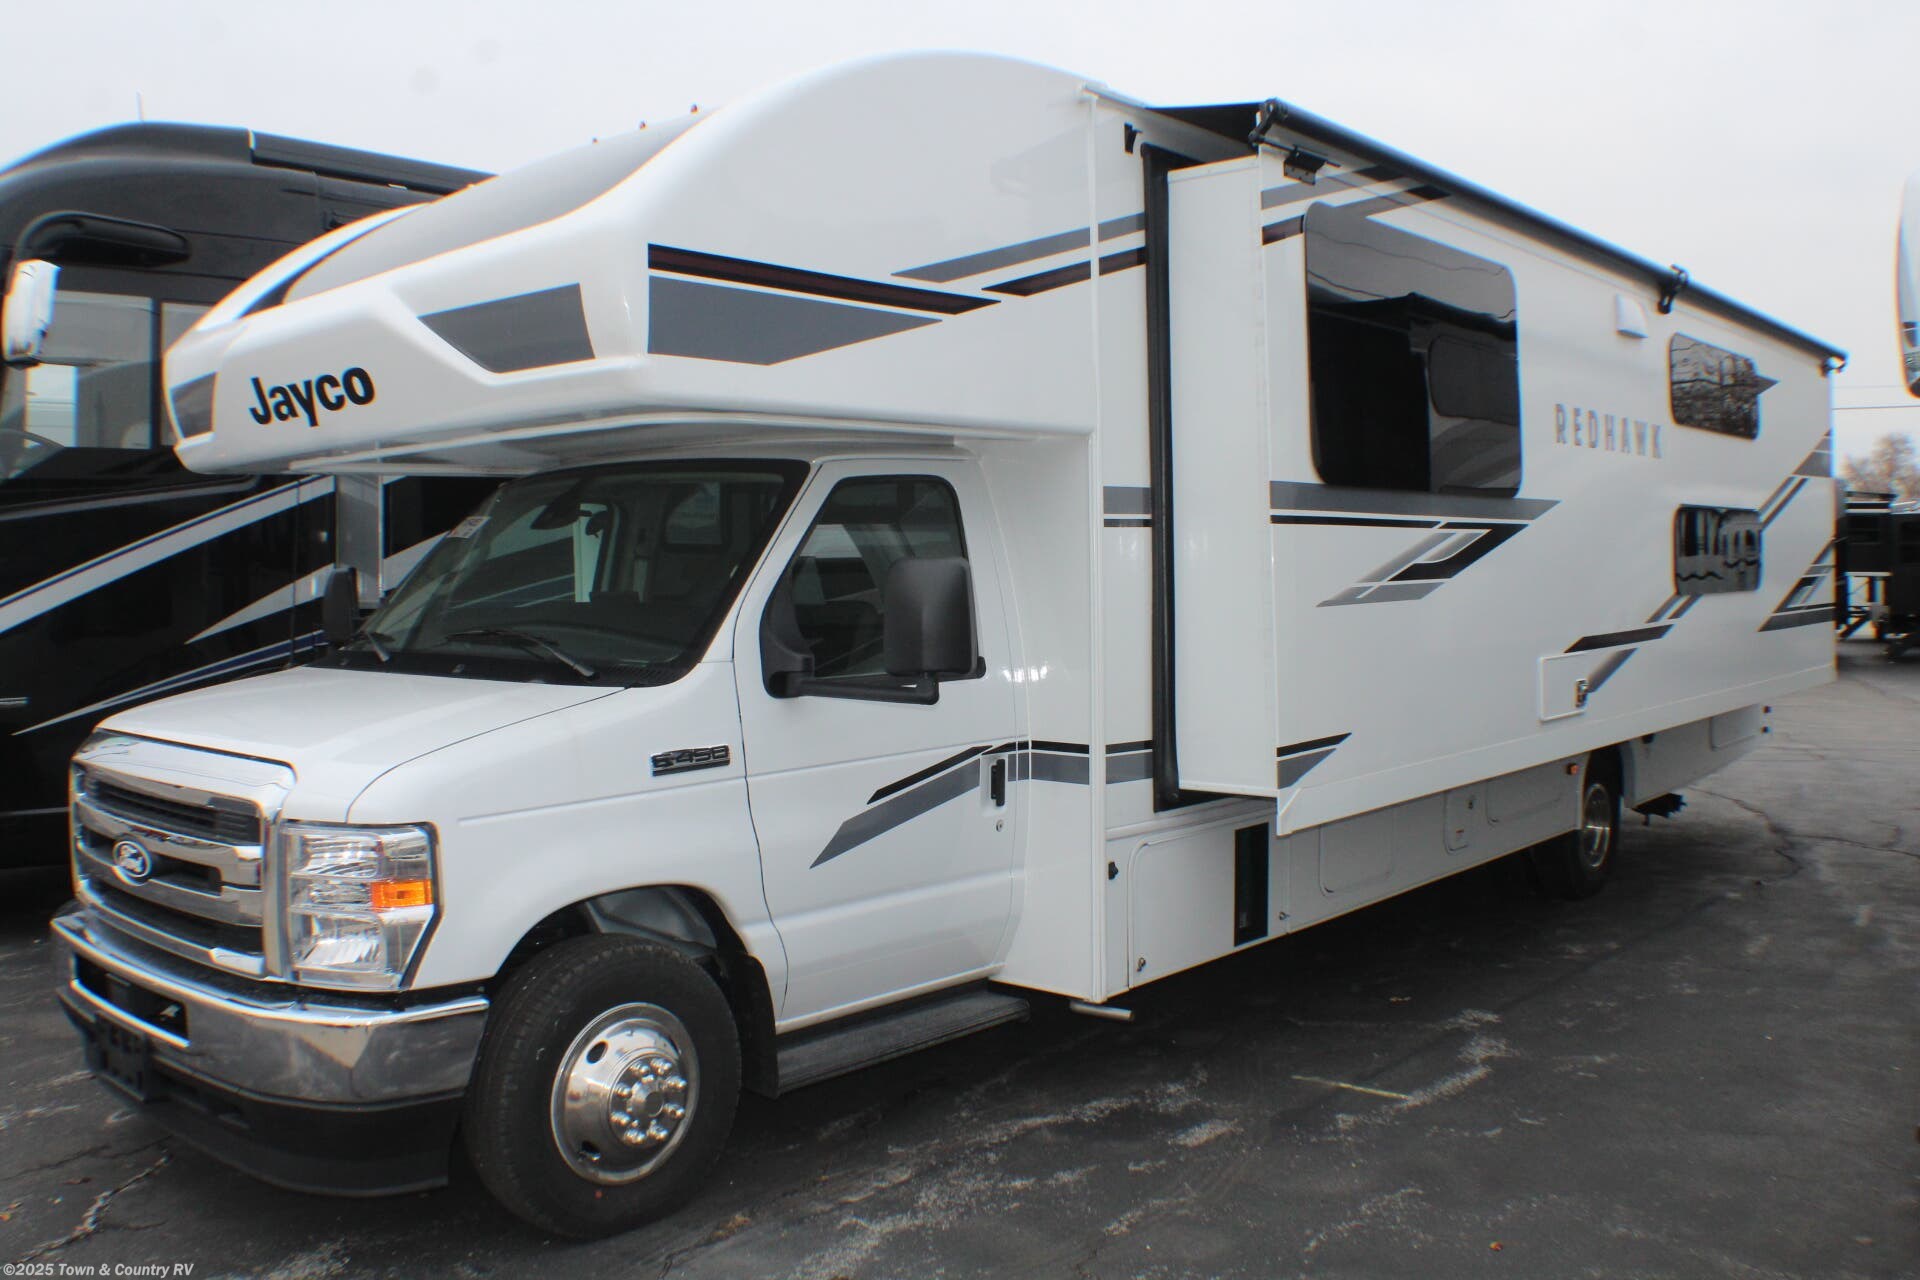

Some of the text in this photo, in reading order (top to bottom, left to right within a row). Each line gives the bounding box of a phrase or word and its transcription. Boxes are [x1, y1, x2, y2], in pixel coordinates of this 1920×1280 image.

[248, 367, 376, 428] Jayco
[1554, 403, 1663, 459] REDHAWK
[118, 845, 144, 873] Ford
